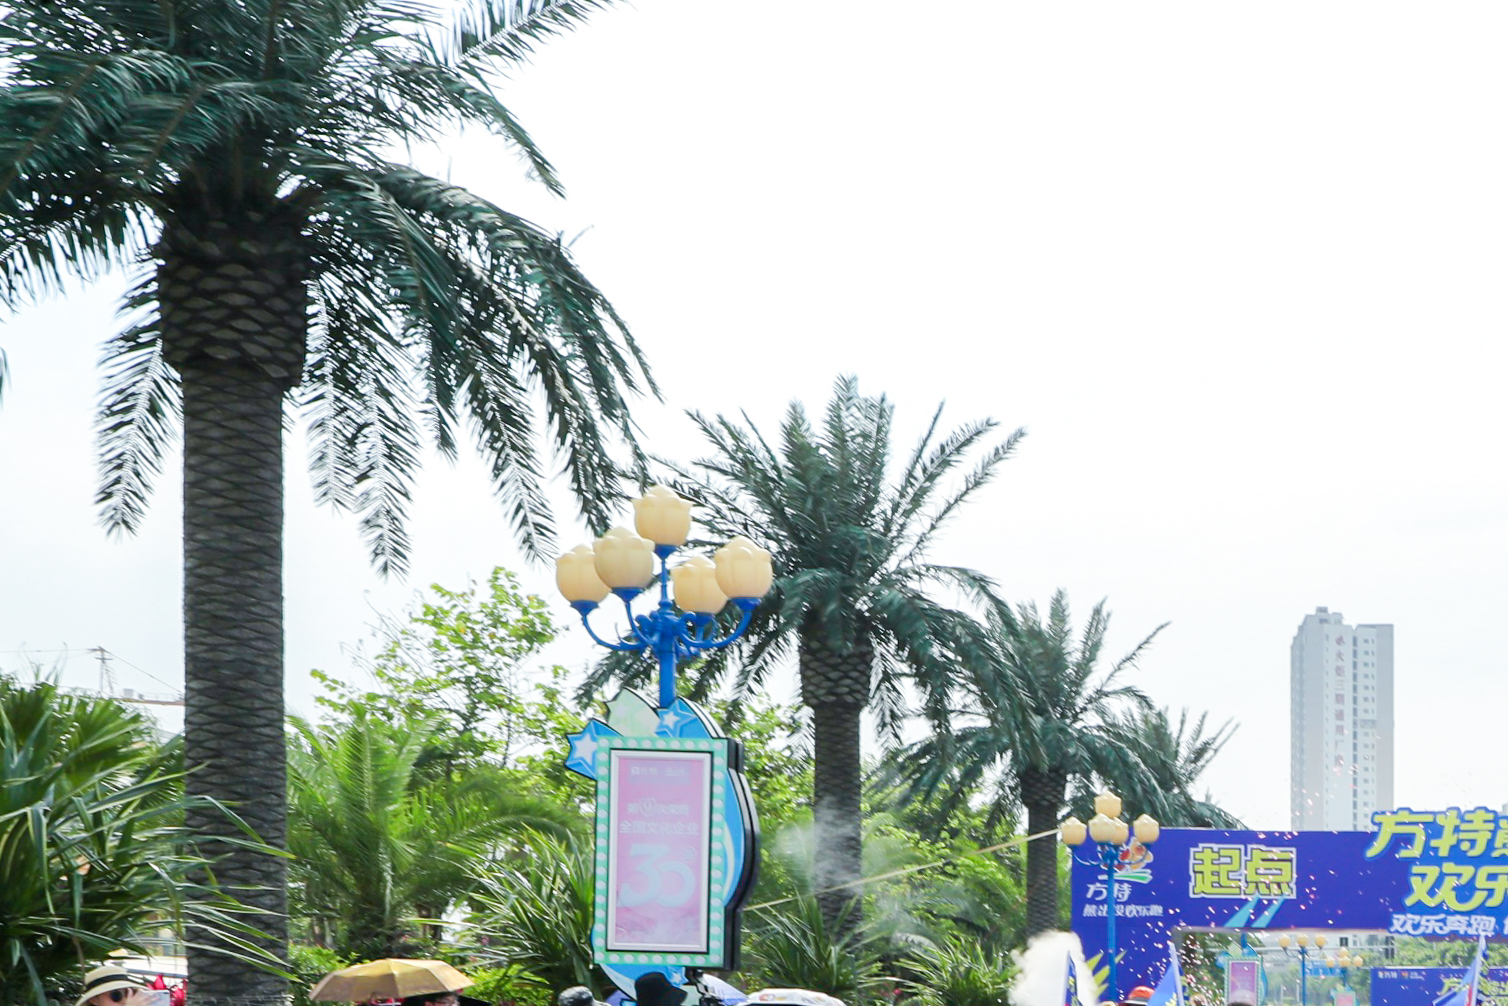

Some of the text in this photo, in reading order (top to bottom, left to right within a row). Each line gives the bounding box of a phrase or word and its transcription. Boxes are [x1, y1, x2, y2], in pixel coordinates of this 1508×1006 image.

[1190, 845, 1296, 898] 起点
[1389, 914, 1496, 936] 欢乐奔跑
